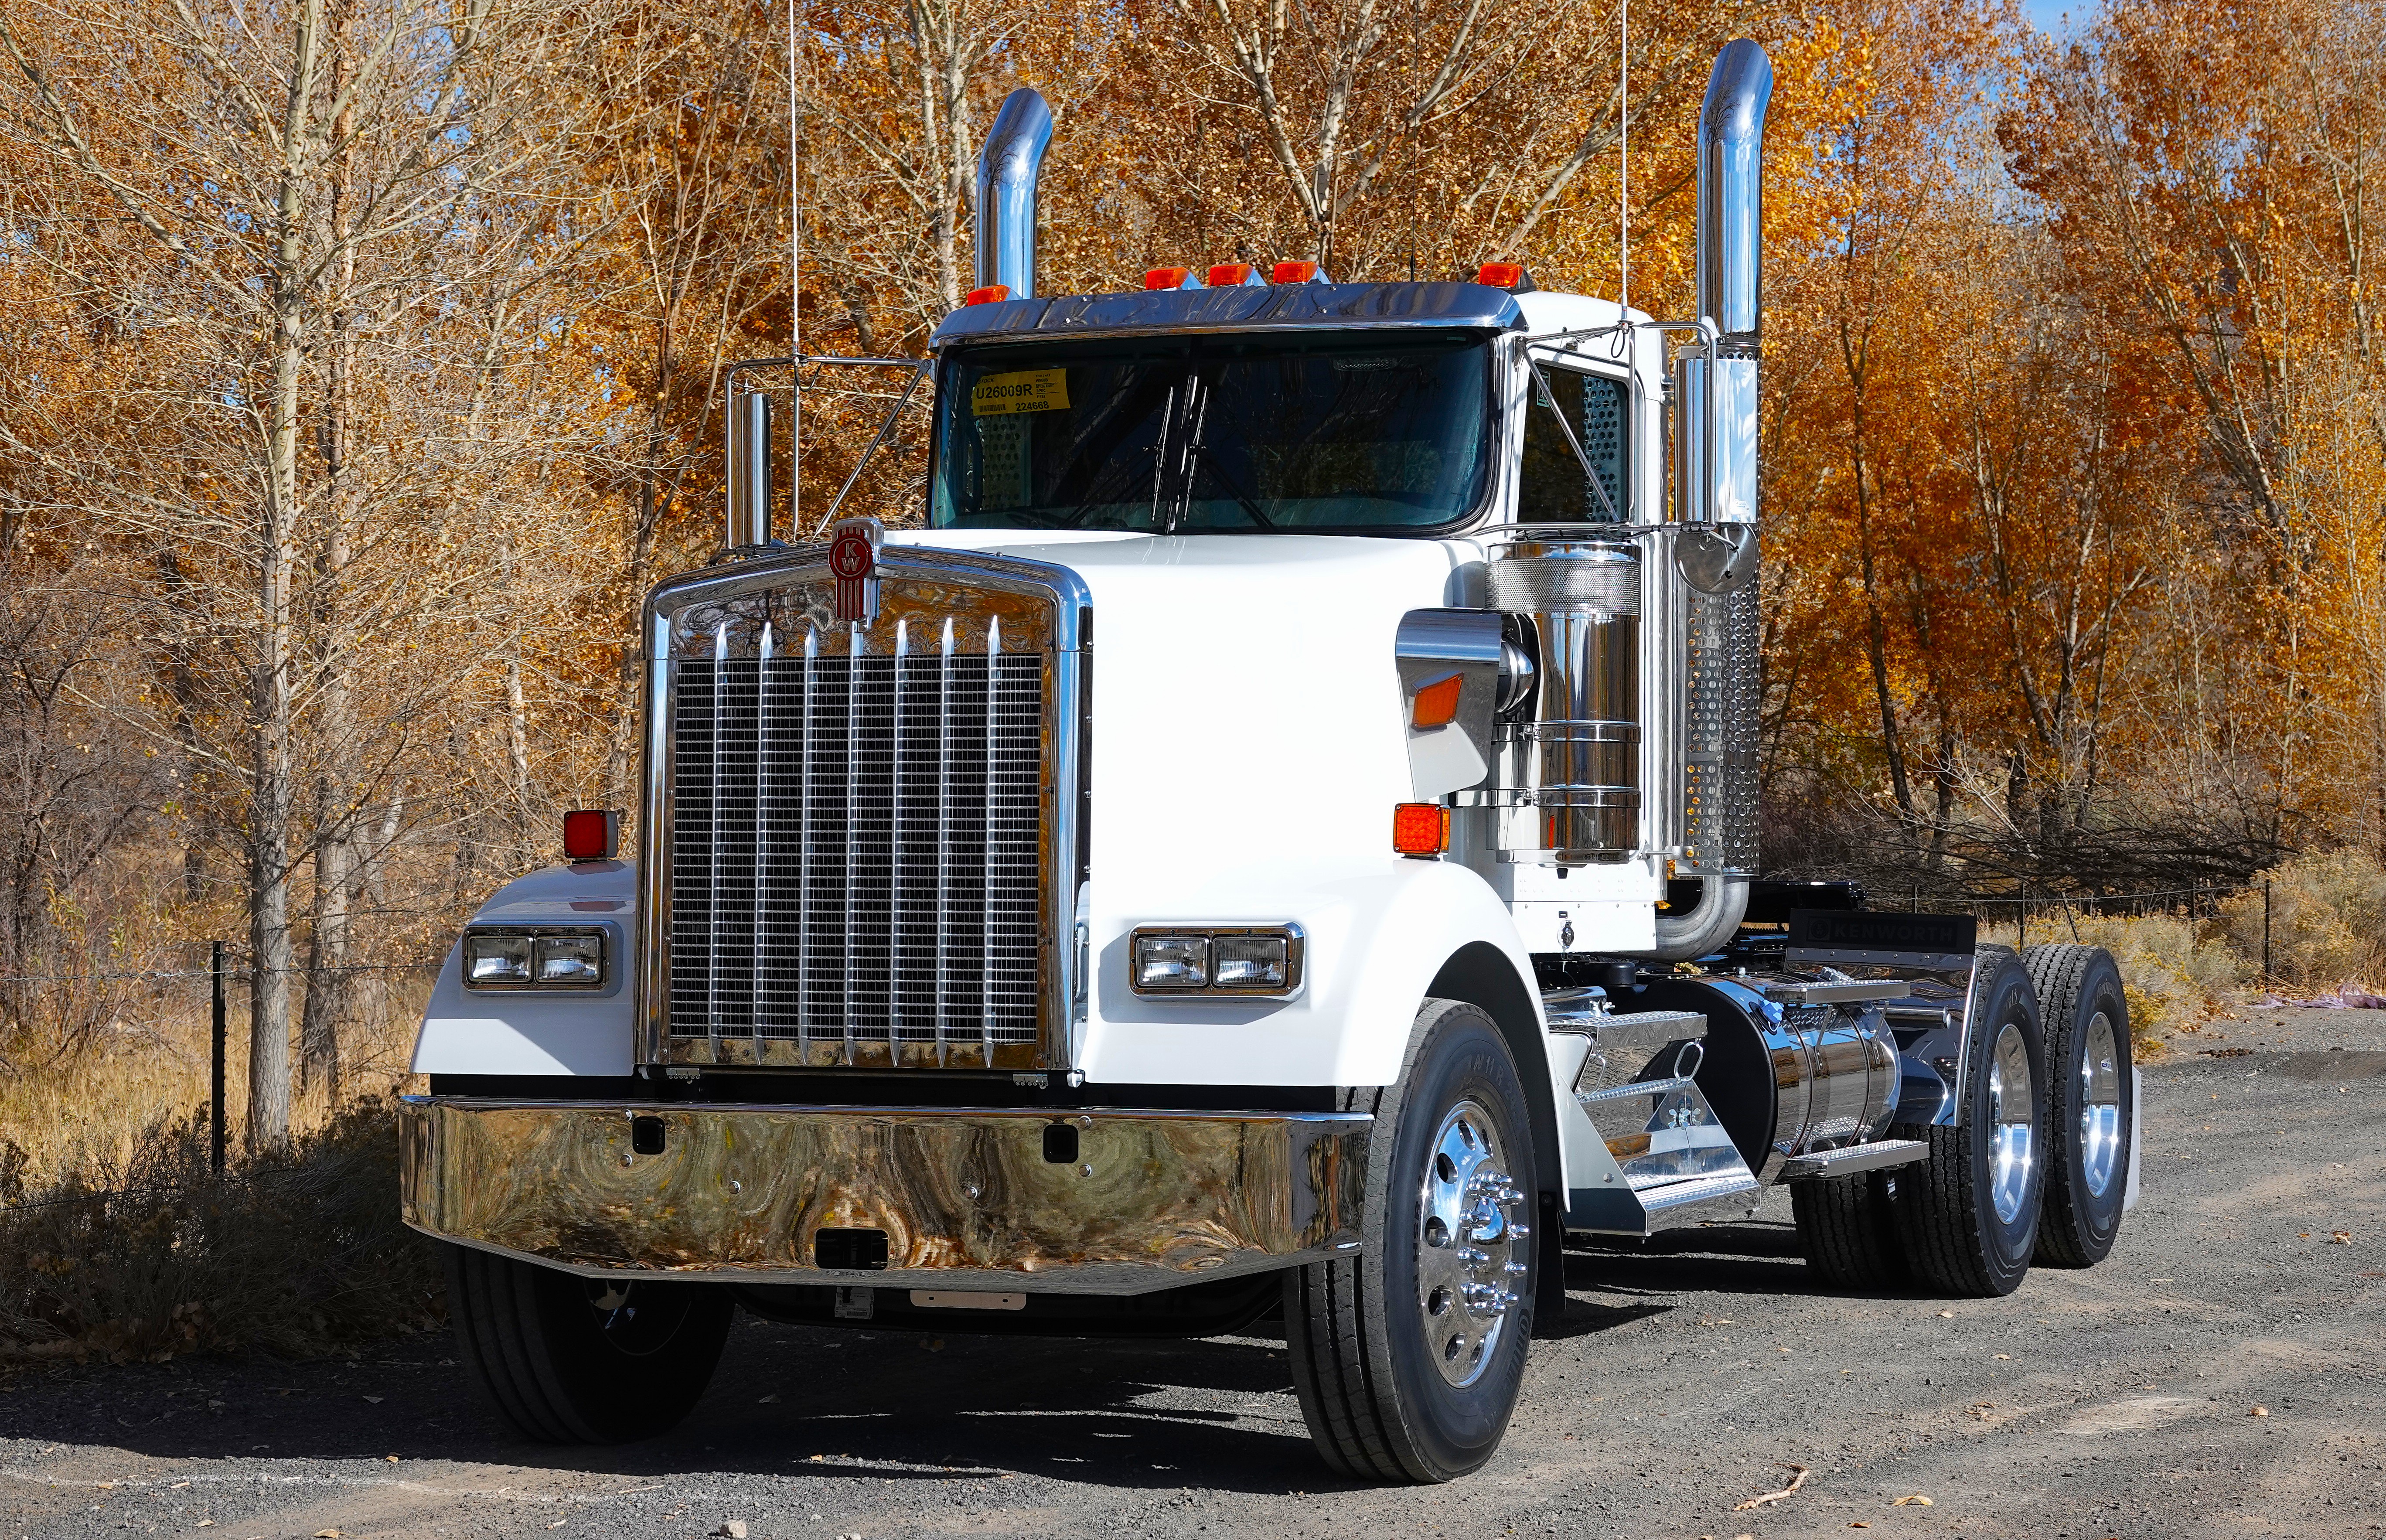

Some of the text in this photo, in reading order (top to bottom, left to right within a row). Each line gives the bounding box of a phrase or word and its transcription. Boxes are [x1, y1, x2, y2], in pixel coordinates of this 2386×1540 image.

[976, 384, 1033, 399] U26009R
[1016, 401, 1049, 411] 224668
[1834, 923, 1953, 942] KENWORTH
